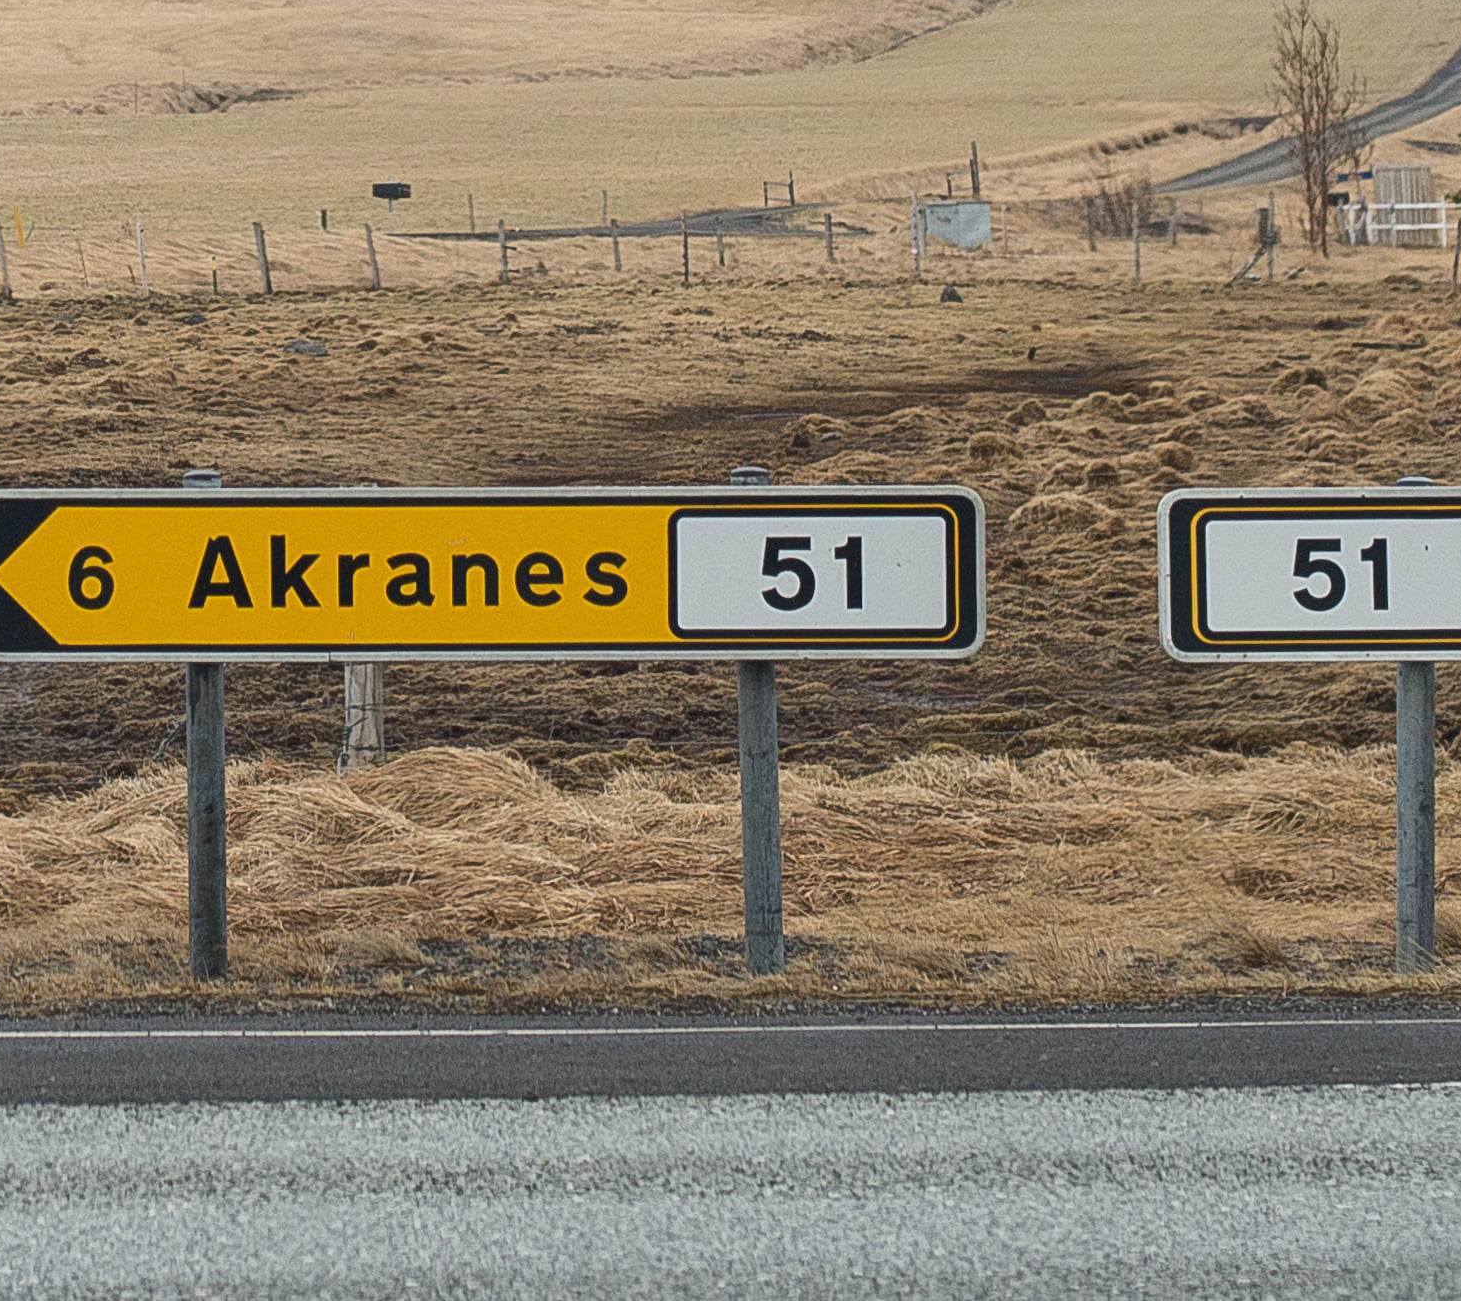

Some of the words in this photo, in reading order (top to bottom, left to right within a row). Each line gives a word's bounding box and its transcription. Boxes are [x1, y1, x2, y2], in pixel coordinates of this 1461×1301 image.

[68, 546, 115, 610] 6
[187, 535, 629, 610] Akranes
[761, 536, 864, 612] 51
[1293, 538, 1390, 613] 51
